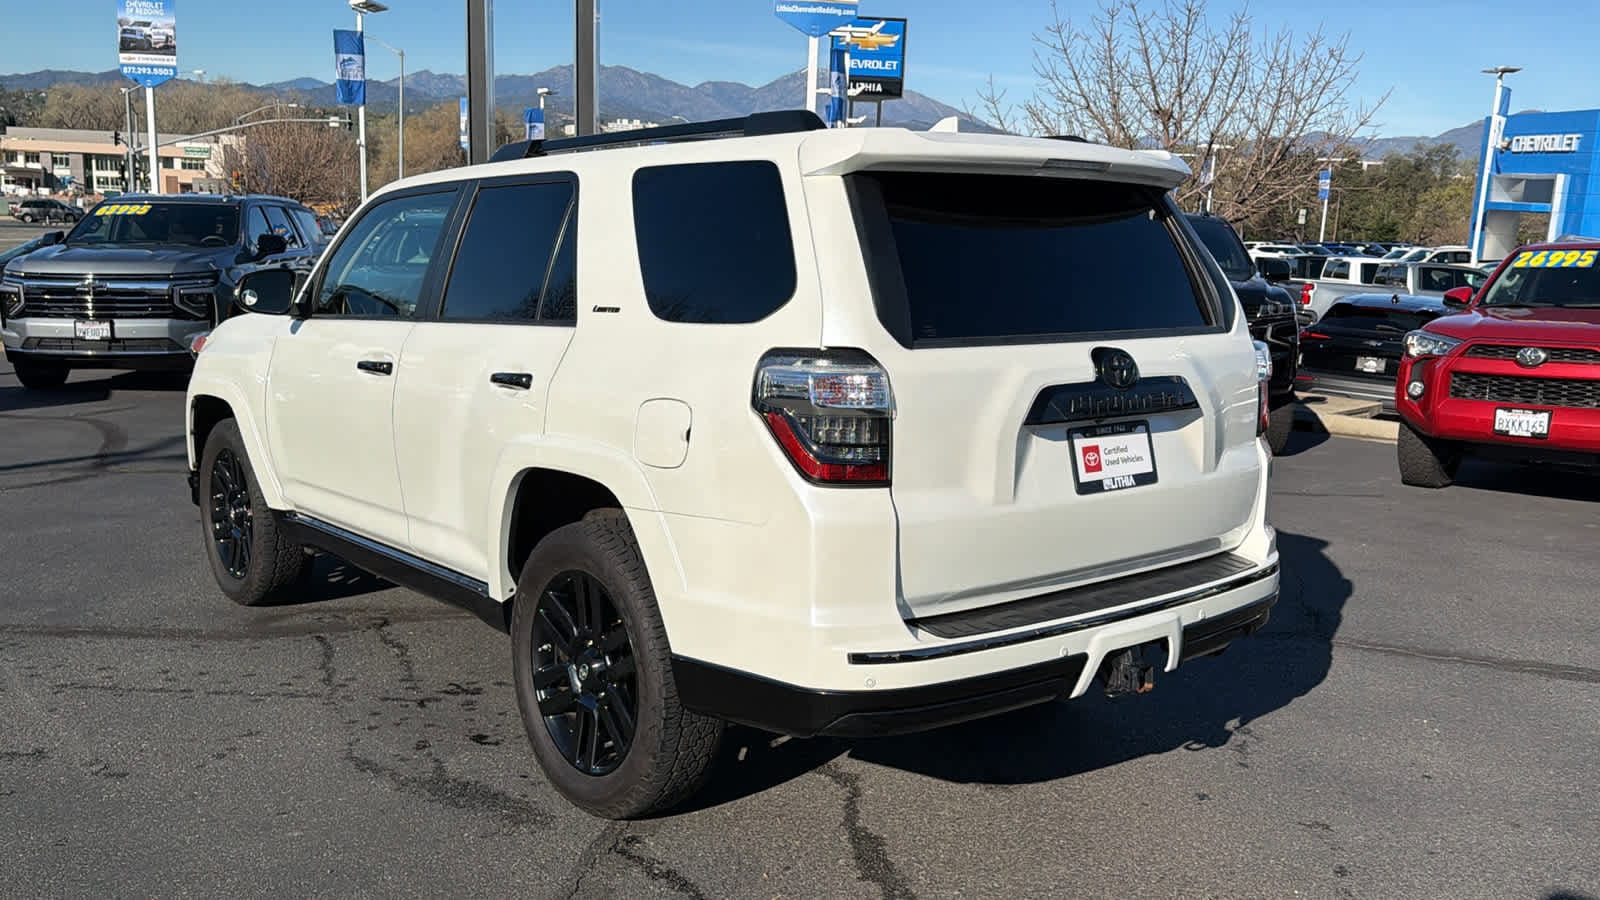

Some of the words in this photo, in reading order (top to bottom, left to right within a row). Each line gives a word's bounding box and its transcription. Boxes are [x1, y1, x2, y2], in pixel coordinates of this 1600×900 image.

[850, 59, 898, 70] EVROLET
[1512, 134, 1583, 152] CHEVROLET
[1513, 251, 1598, 267] 26995
[1103, 445, 1128, 455] Certified
[1120, 454, 1144, 464] Vehicles
